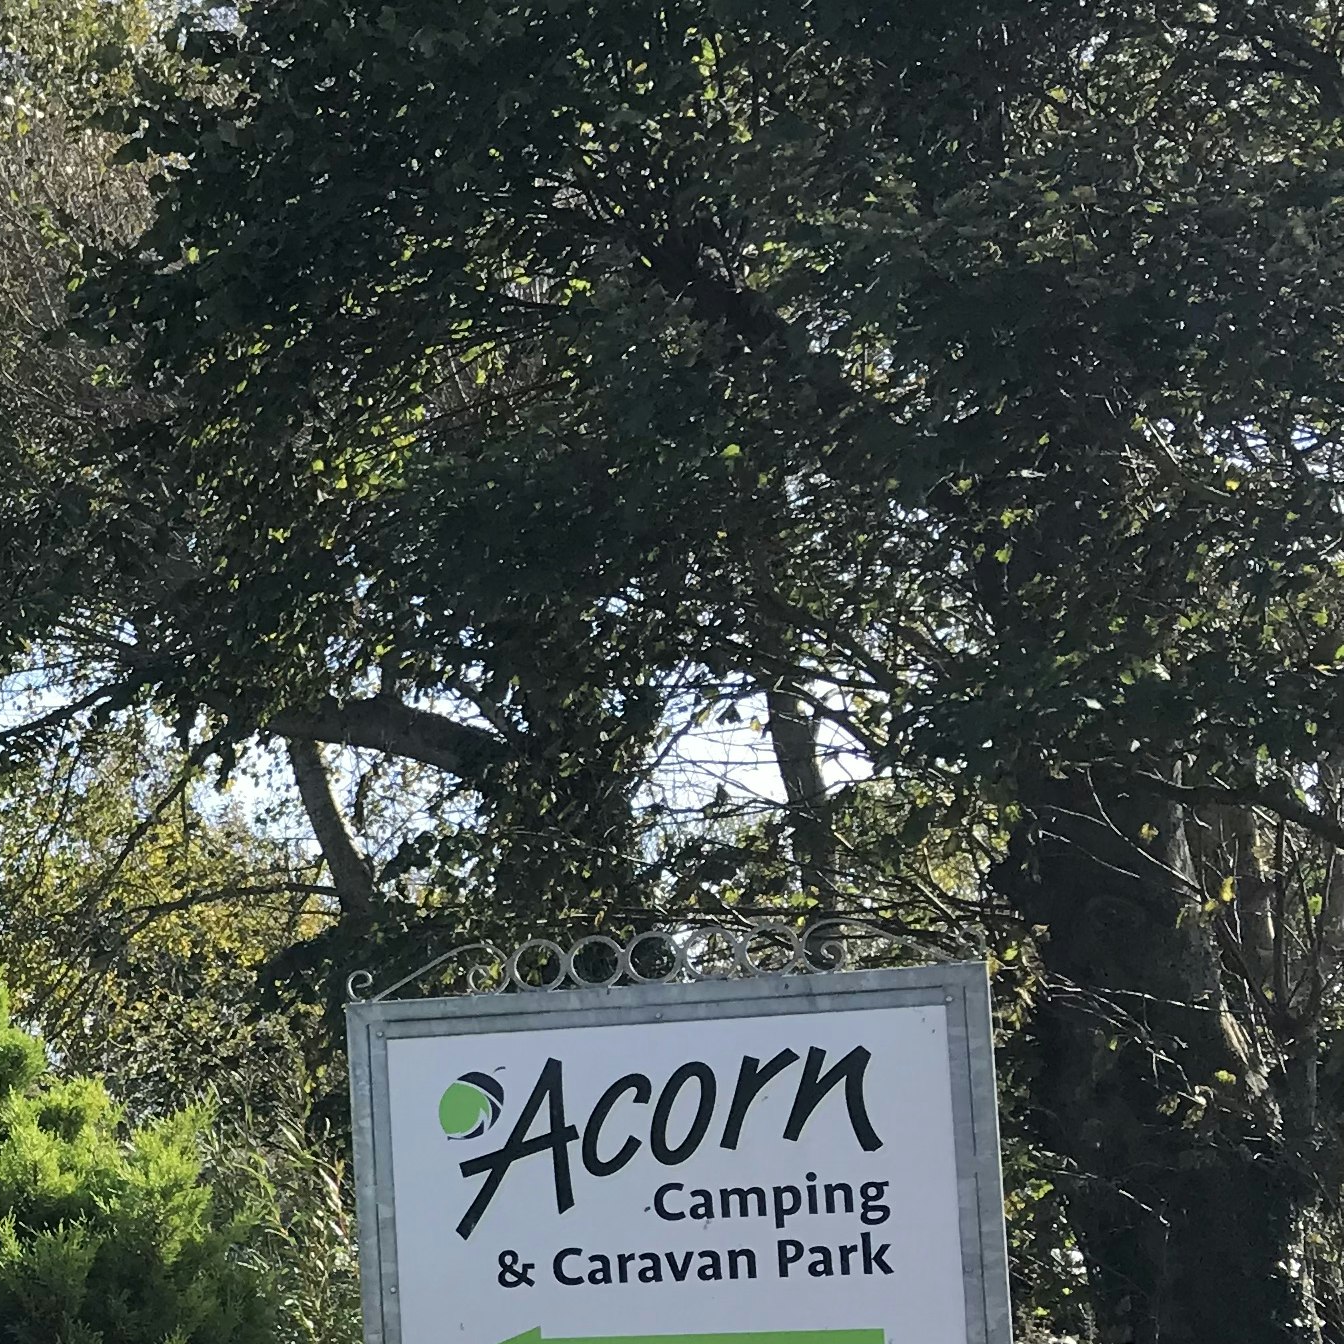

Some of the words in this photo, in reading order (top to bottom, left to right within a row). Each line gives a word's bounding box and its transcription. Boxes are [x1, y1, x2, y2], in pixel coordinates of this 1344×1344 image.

[456, 1045, 883, 1241] Acorn
[653, 1172, 891, 1228] Camping
[497, 1250, 536, 1289] &
[552, 1246, 757, 1287] Caravan
[778, 1232, 894, 1279] Park
